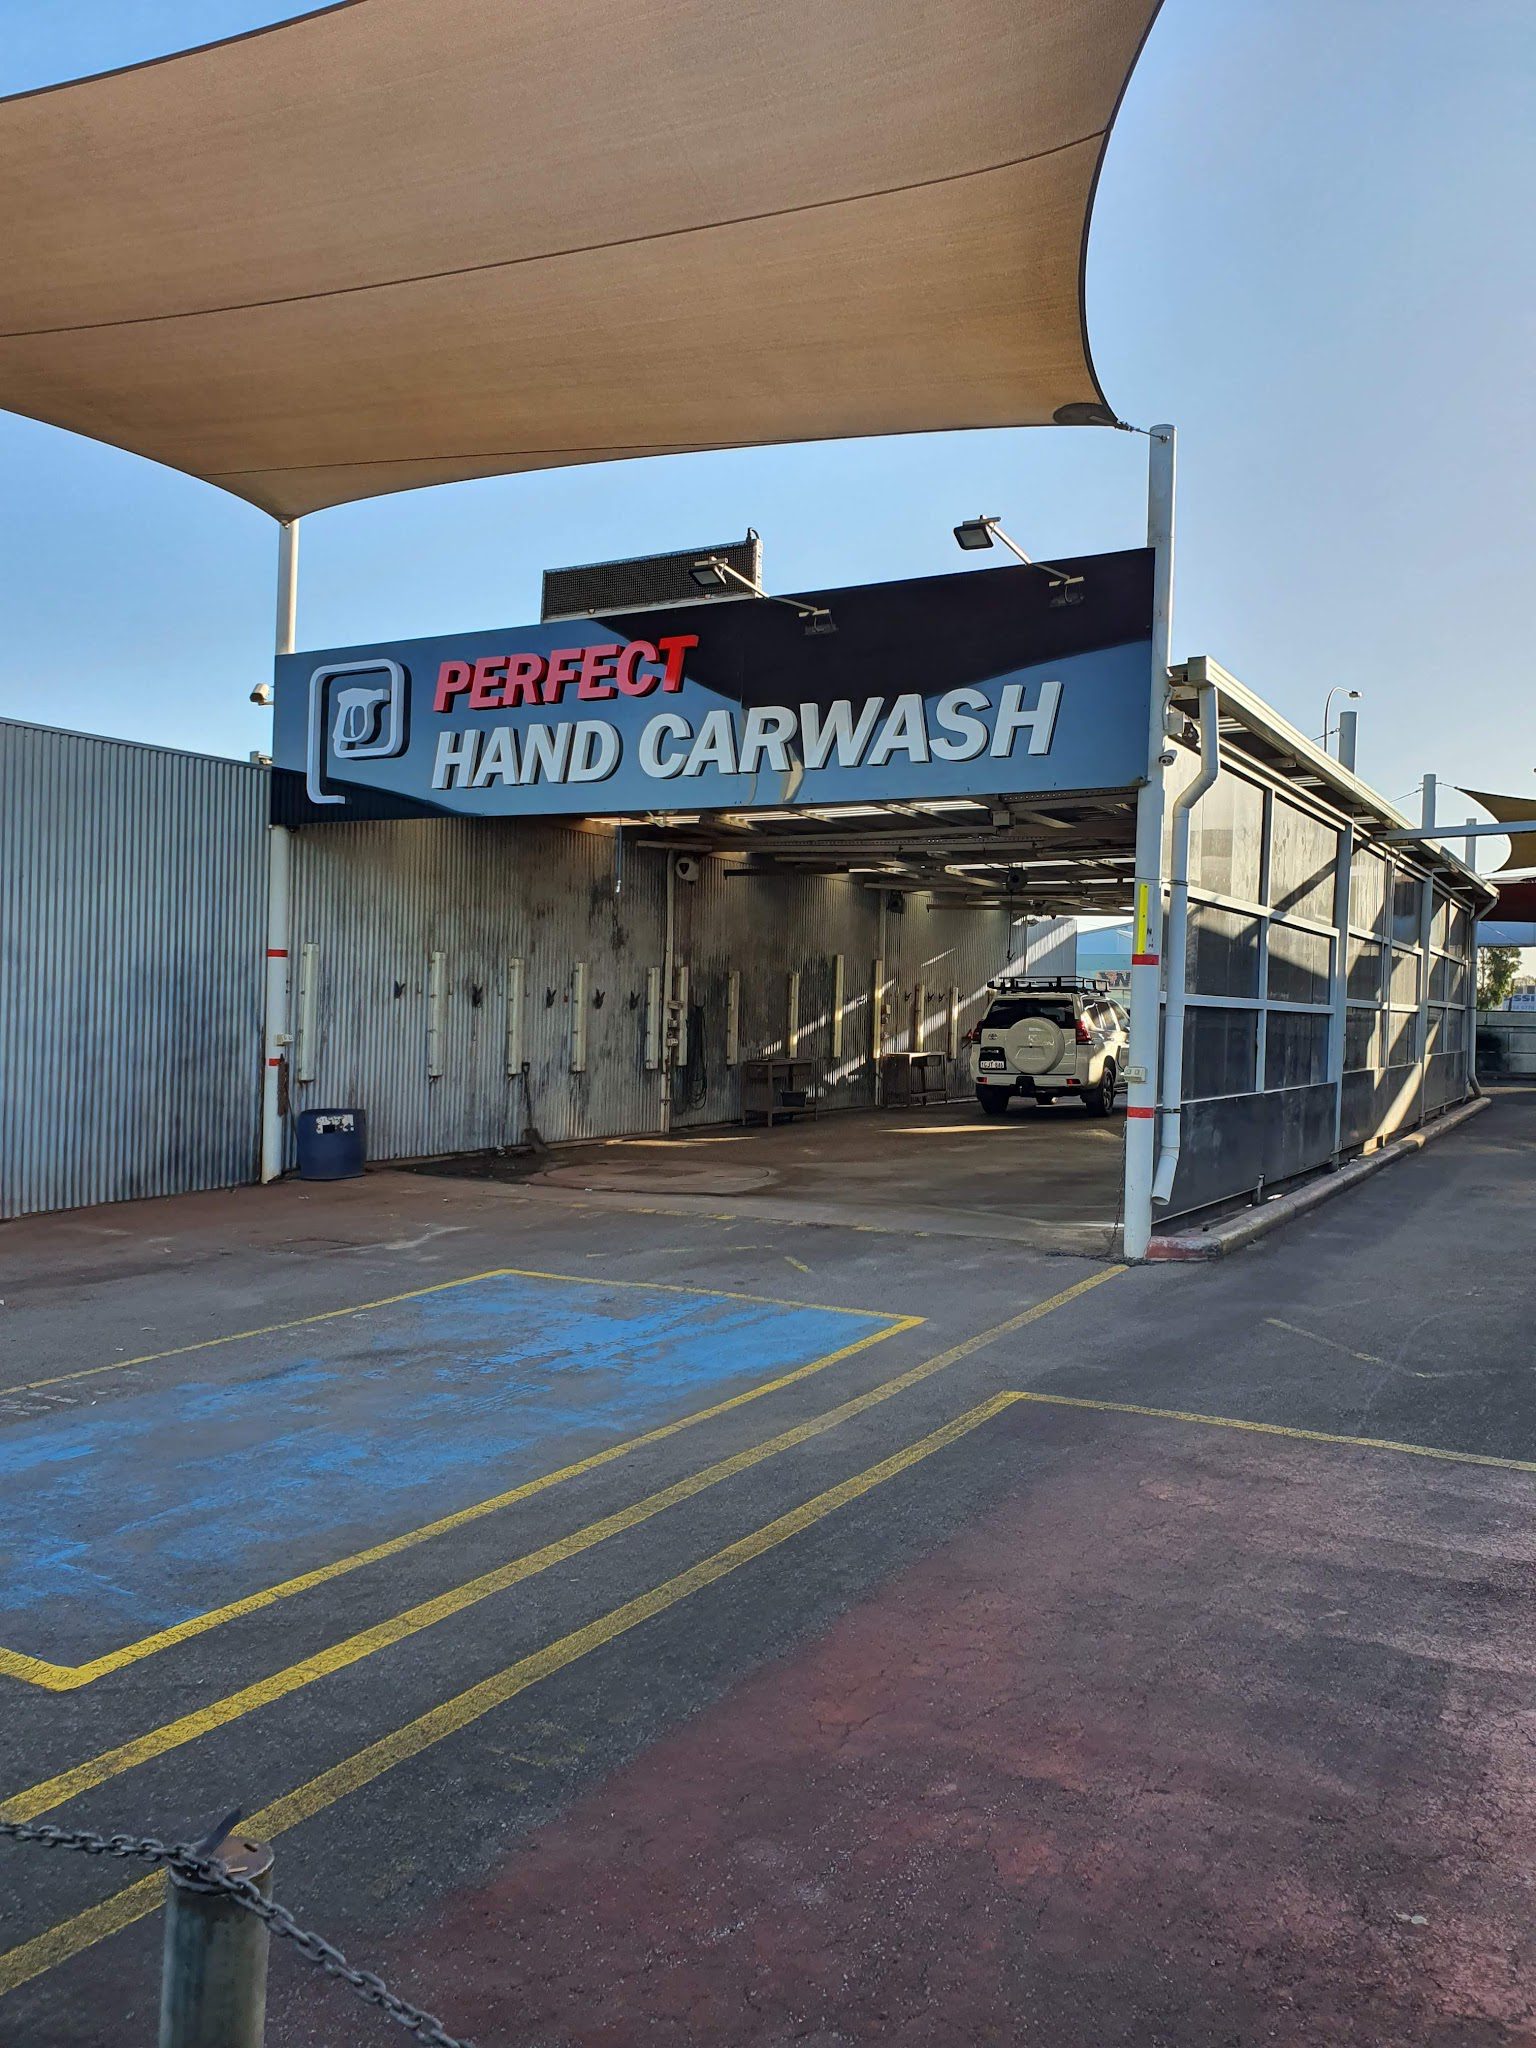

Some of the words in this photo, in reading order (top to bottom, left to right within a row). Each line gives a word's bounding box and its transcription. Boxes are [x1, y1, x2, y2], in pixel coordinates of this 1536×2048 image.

[433, 635, 698, 713] PERFECT
[432, 720, 623, 790] HAND
[639, 681, 1062, 779] CARWASH
